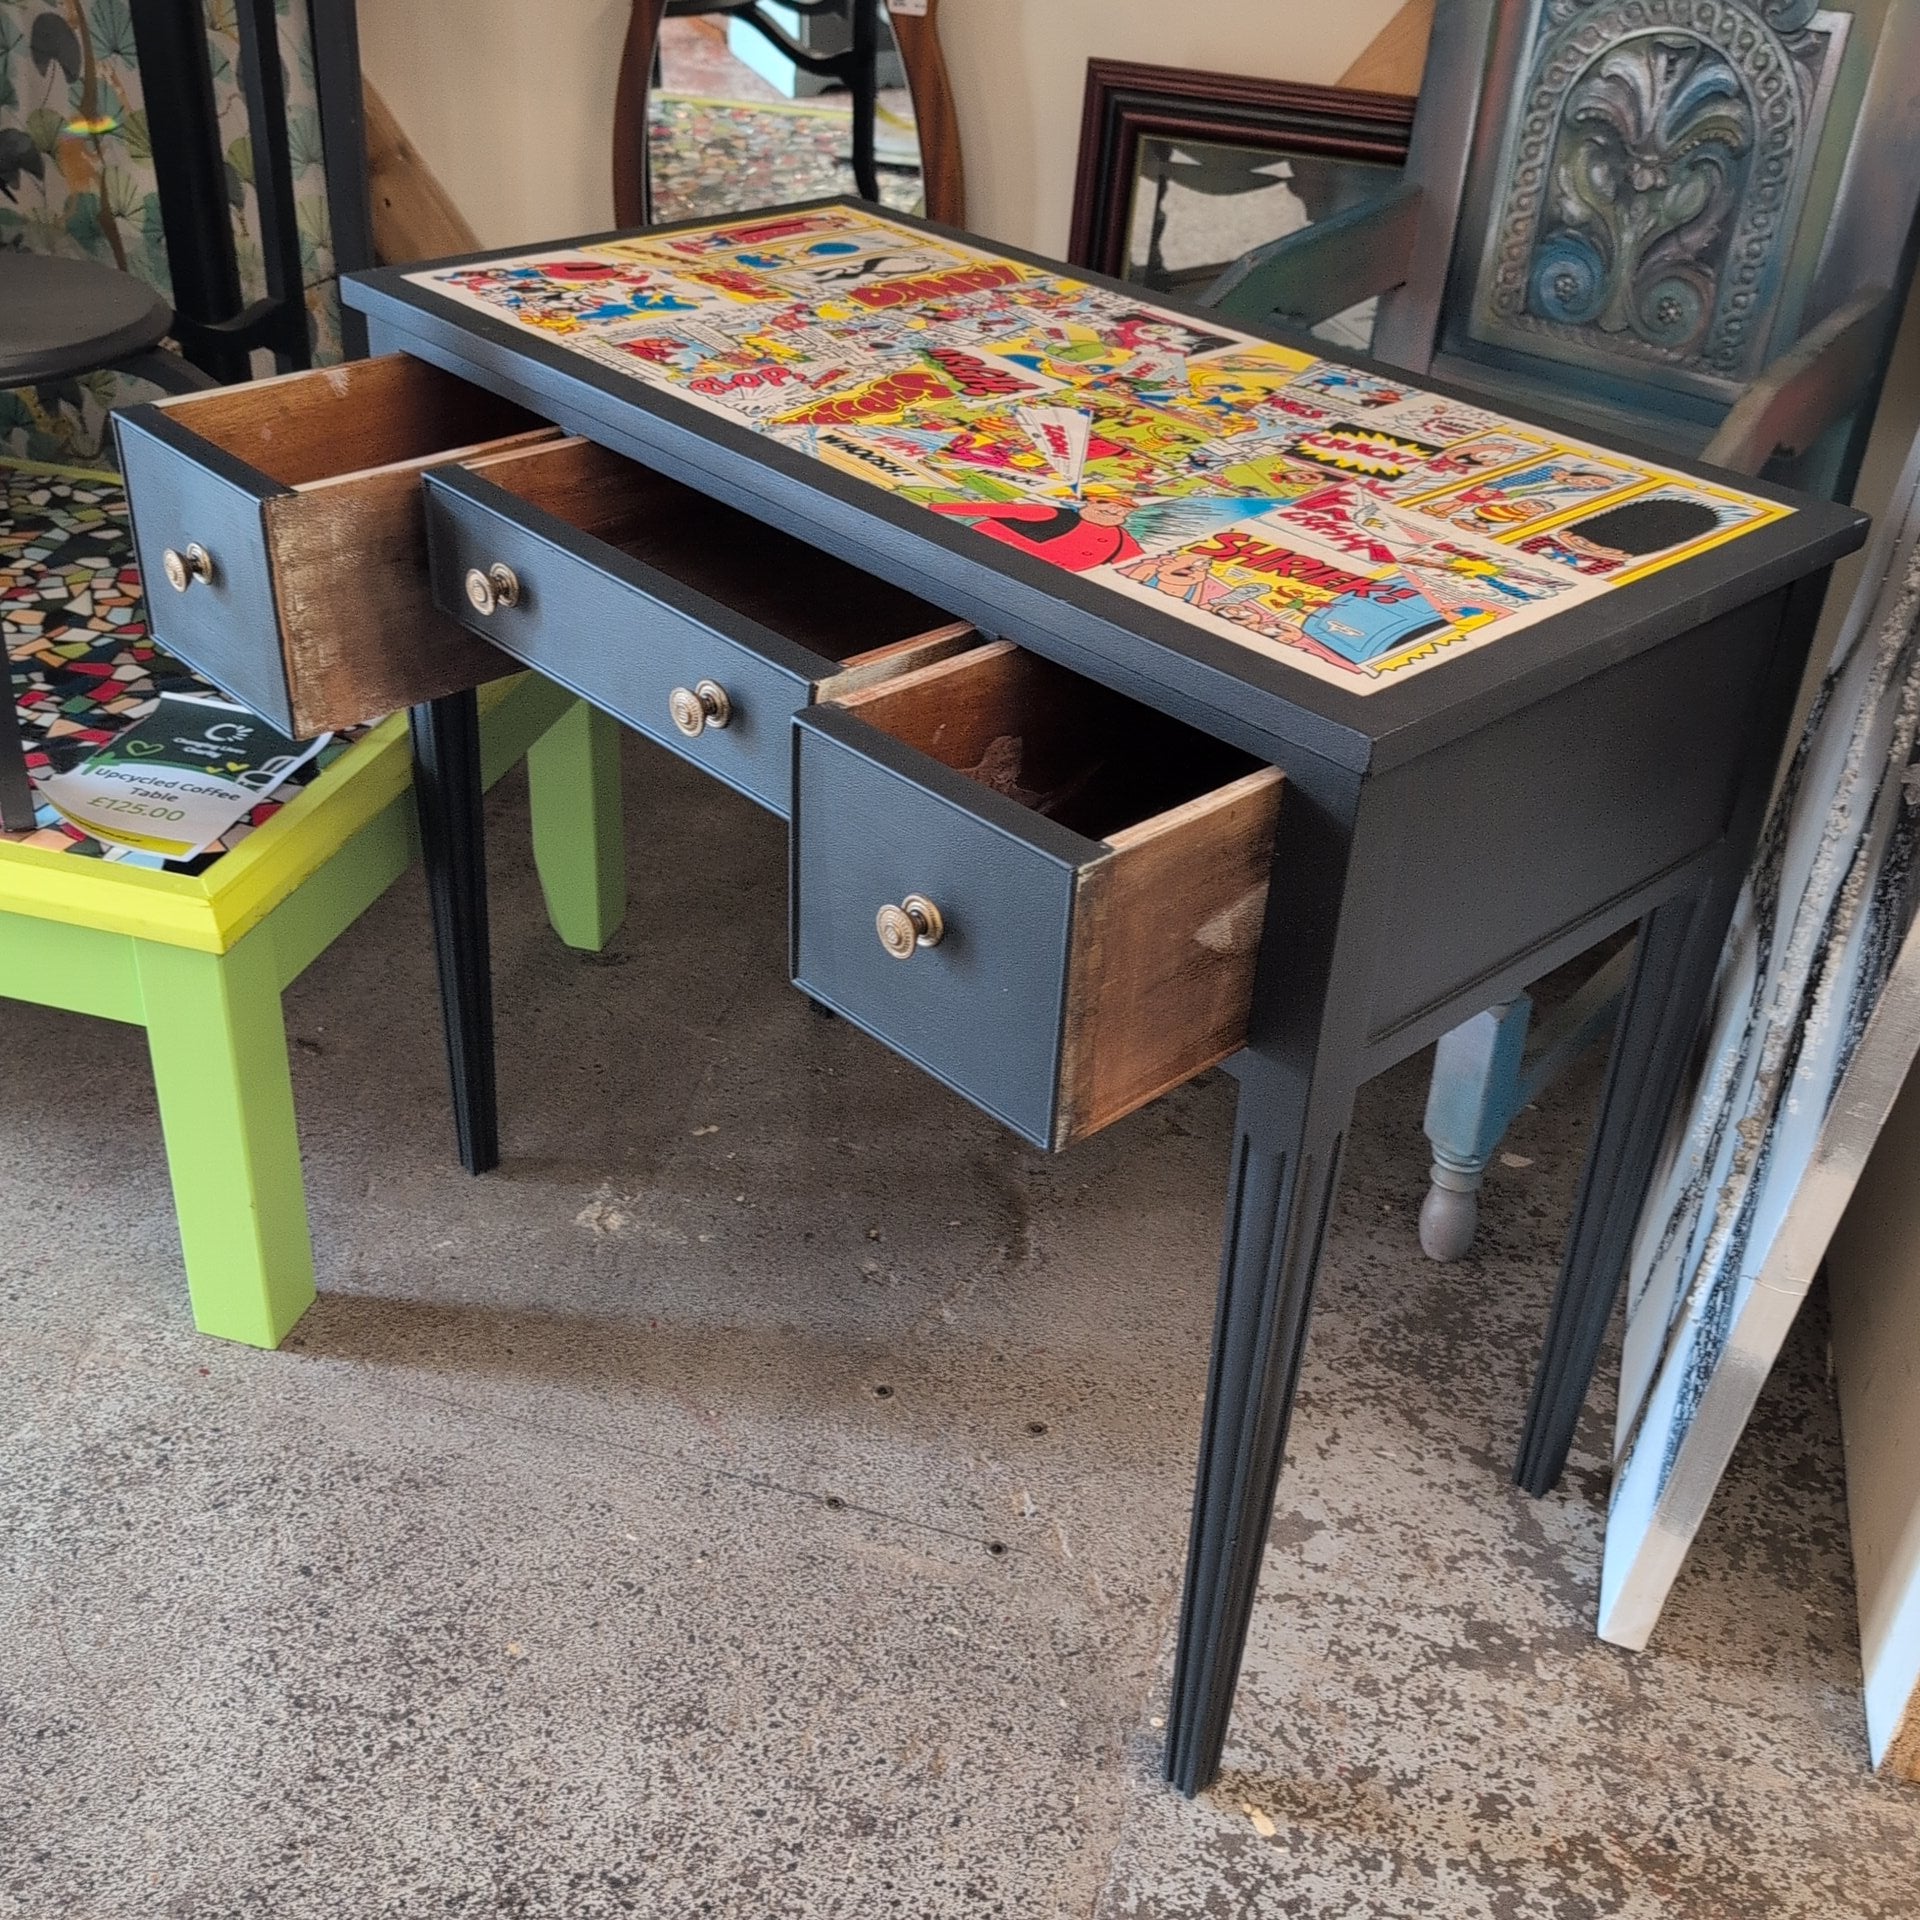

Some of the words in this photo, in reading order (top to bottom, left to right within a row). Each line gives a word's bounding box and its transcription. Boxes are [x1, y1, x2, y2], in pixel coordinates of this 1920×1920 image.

[847, 265, 1026, 310] DANDY
[817, 434, 918, 478] WHOOSH!
[1308, 434, 1427, 465] CRACK!
[1188, 532, 1422, 605] SHRIEK!
[95, 767, 178, 791] Upcycled
[180, 783, 241, 801] Coffee
[130, 787, 179, 802] Table
[86, 796, 186, 822] £125.00
